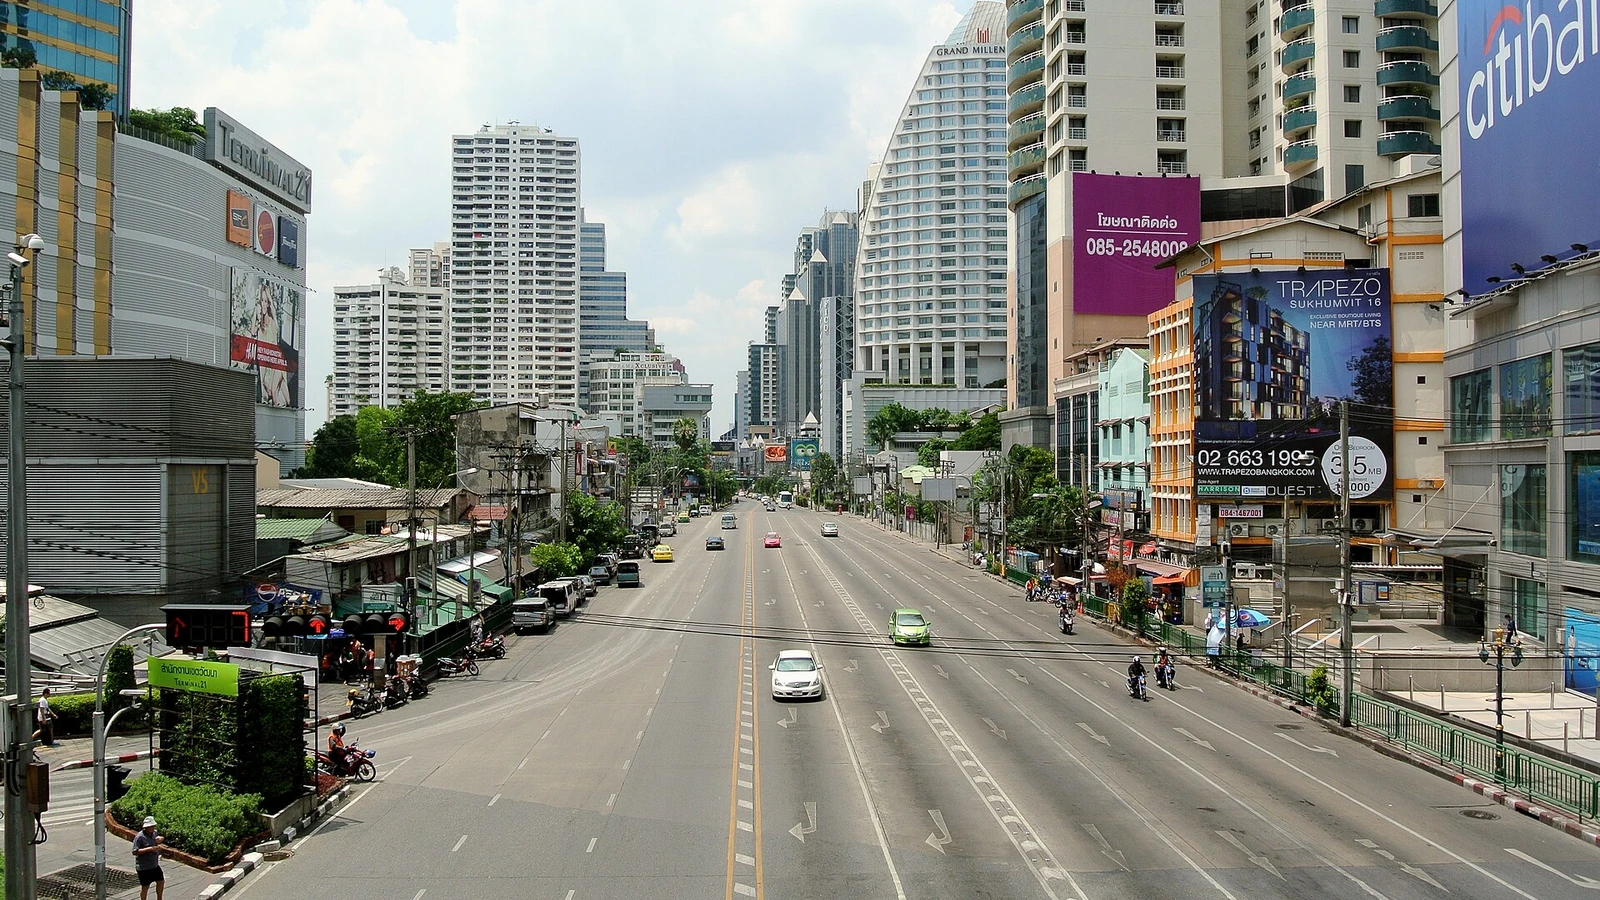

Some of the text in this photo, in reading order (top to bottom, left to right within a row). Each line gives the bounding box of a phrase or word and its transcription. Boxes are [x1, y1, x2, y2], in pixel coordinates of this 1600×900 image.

[936, 46, 969, 56] GRAND
[1466, 0, 1599, 139] citiba
[1097, 212, 1178, 229] โฆษณาติดต่อ
[1276, 277, 1381, 298] TRAPEZO
[1289, 297, 1382, 309] SUKHUMVIT 16
[1309, 319, 1382, 329] NEAR MRT/BTS
[1197, 449, 1315, 467] 02 663 1995
[1197, 468, 1315, 476] WWW.TRAPEZOBANGKOK.COM
[1220, 509, 1262, 517] 084-1467001
